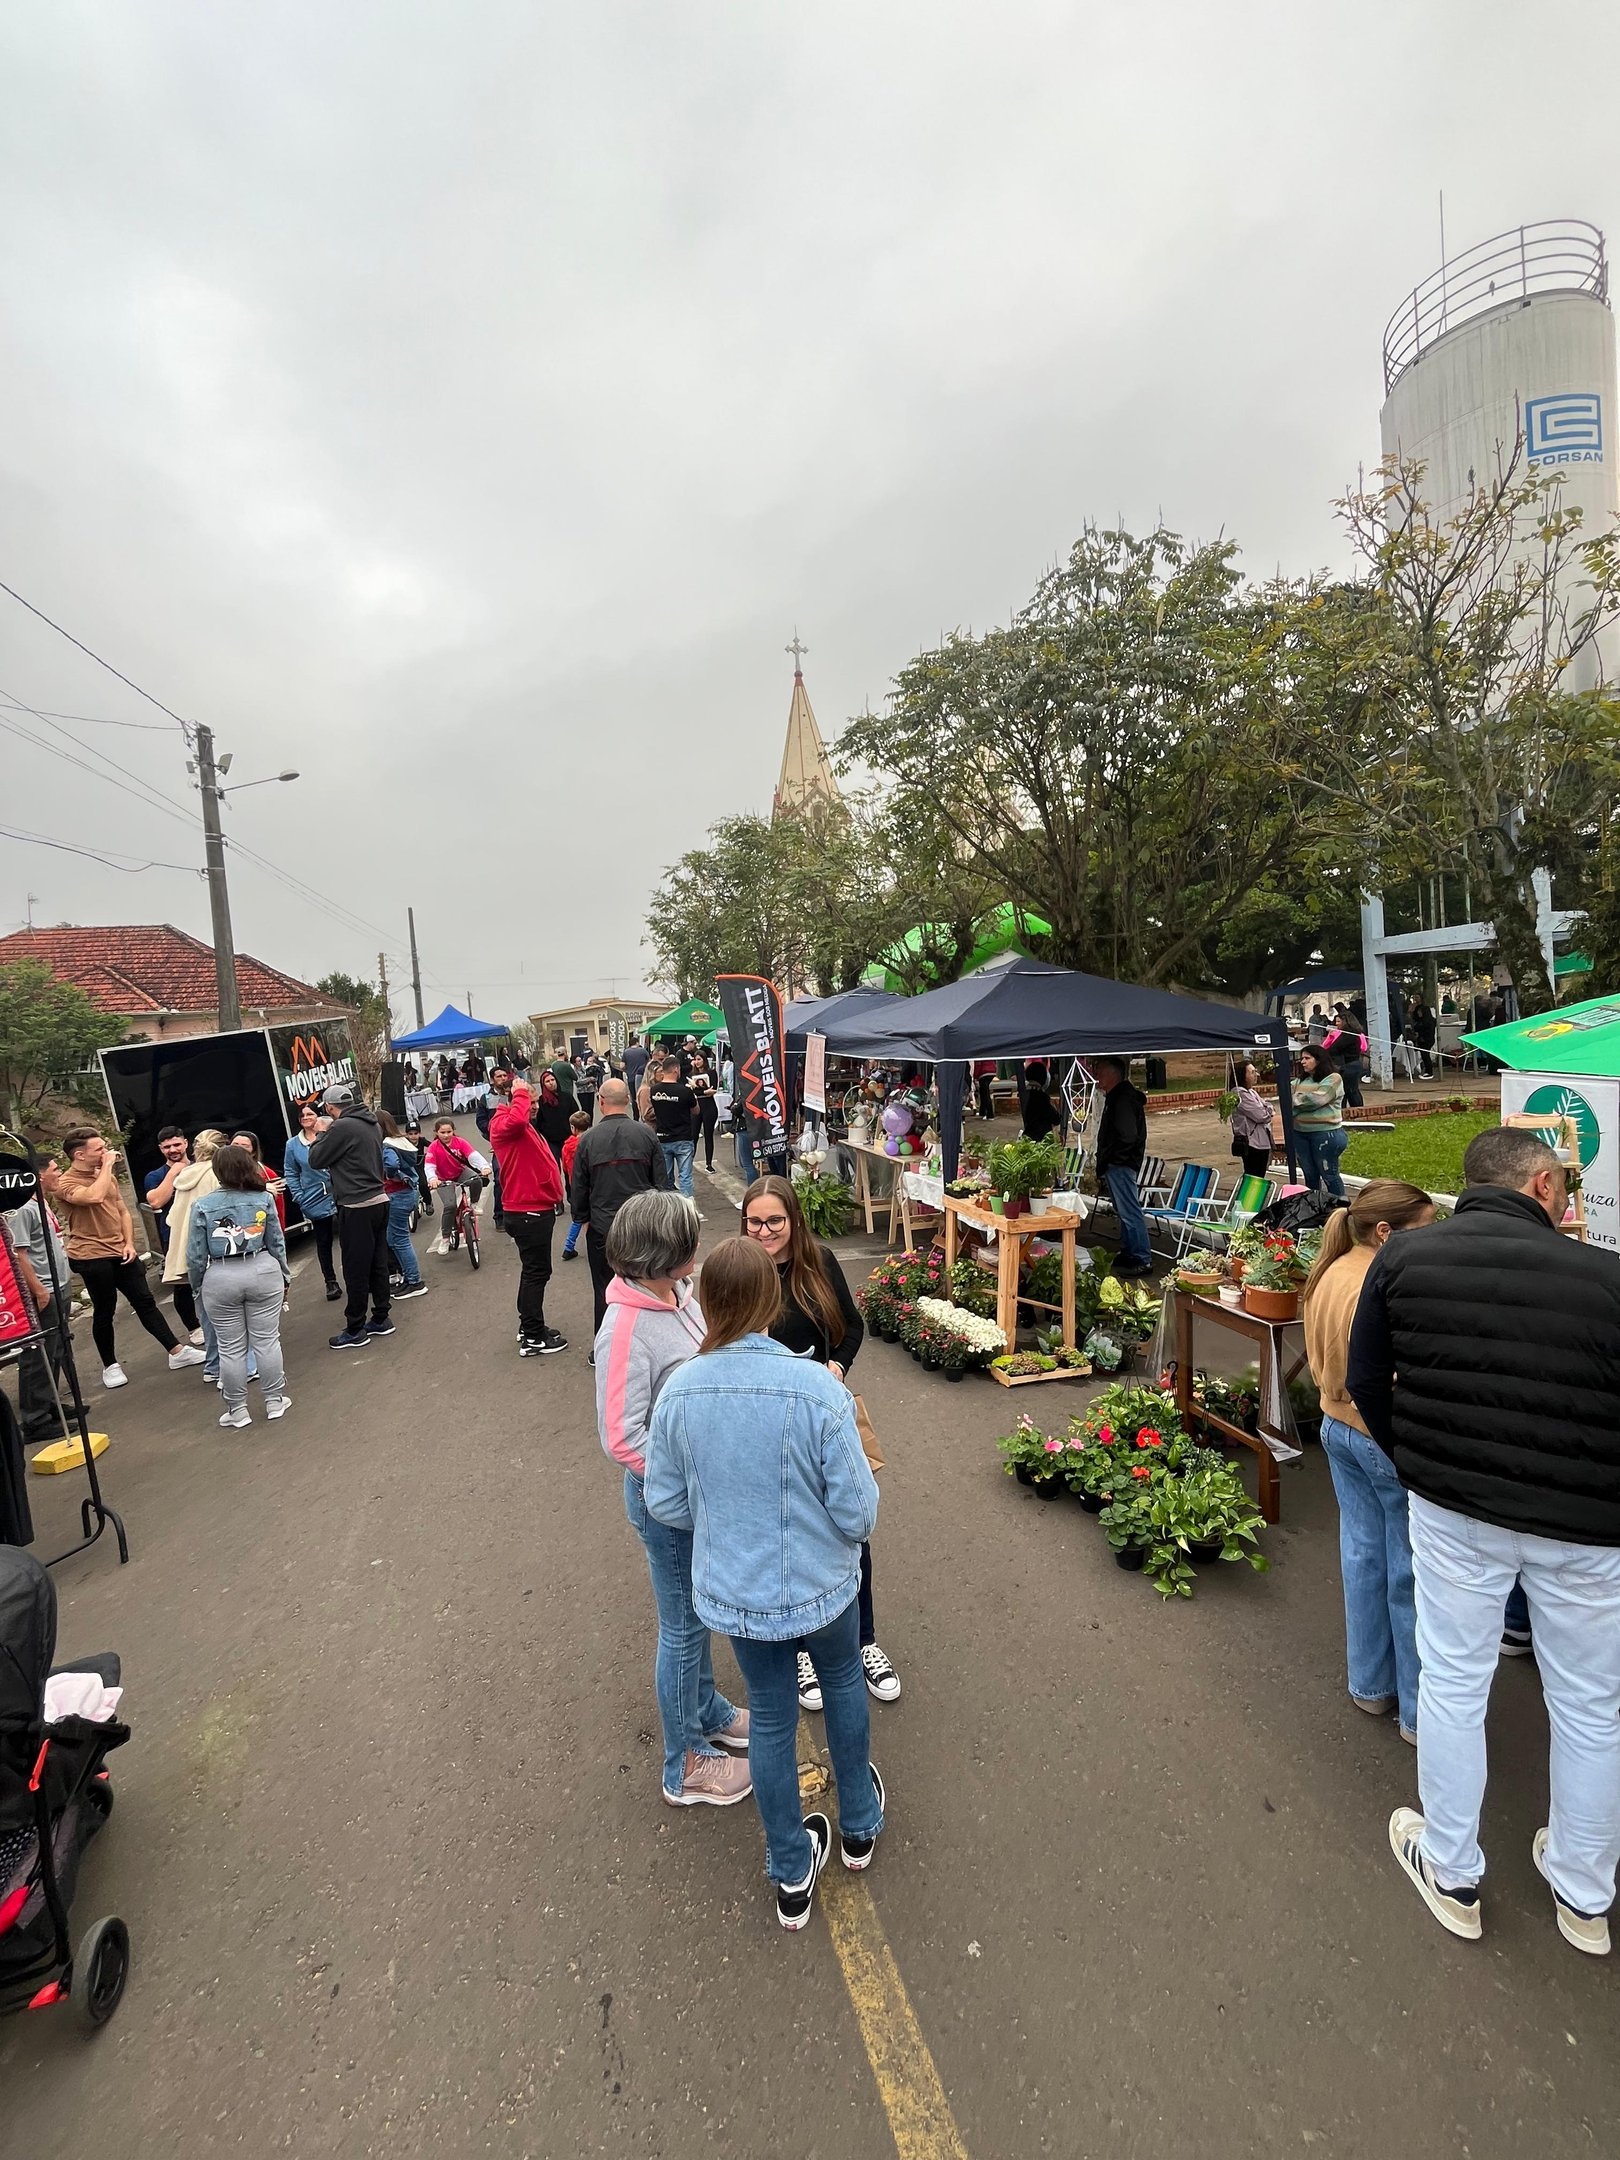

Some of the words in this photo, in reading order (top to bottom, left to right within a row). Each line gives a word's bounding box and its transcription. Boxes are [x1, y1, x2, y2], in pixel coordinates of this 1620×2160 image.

[1528, 451, 1603, 466] CORSAN
[609, 1021, 617, 1057] ARTIGOS
[745, 988, 770, 1051] BLATT
[285, 1064, 328, 1101] MÓVEIS
[326, 1058, 353, 1086] BLATT
[760, 1054, 785, 1135] MÓVEIS
[1583, 1193, 1617, 1208] uza
